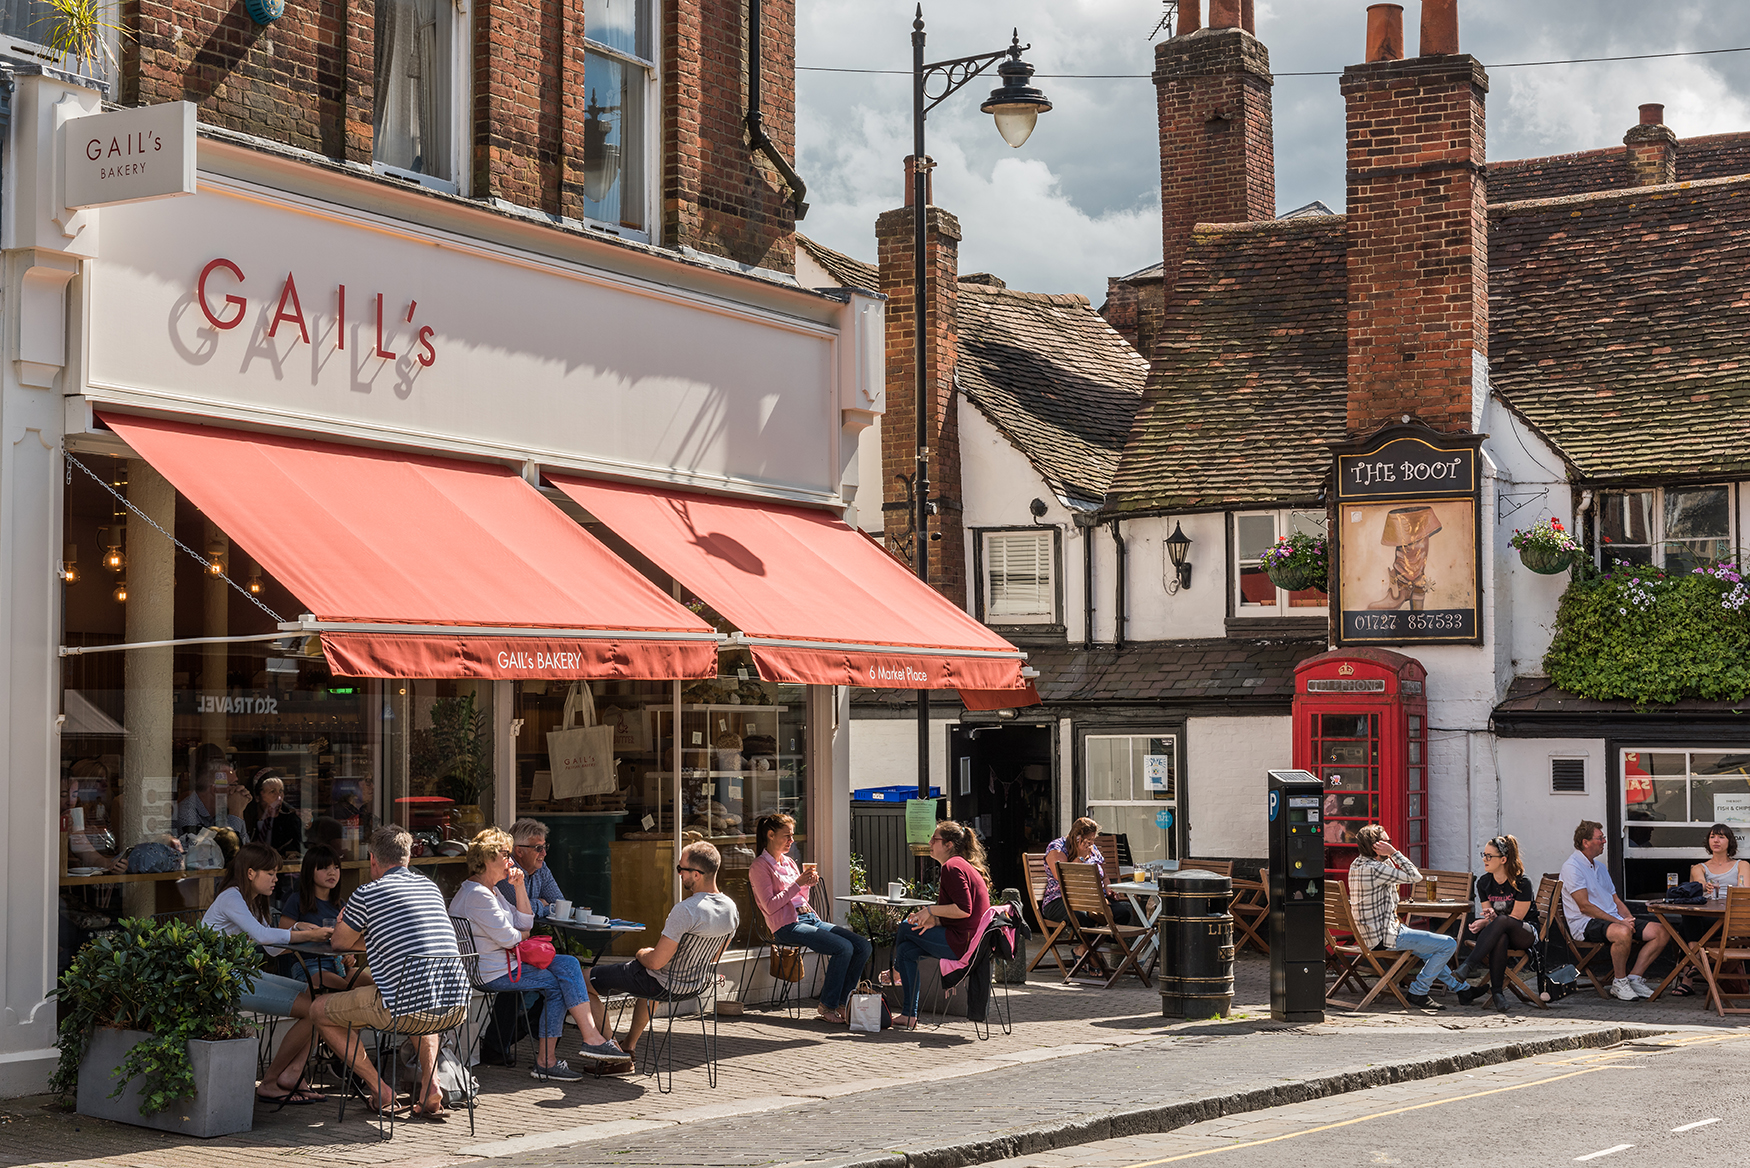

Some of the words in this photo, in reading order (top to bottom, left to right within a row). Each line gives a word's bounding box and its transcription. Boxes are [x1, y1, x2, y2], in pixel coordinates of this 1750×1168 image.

[86, 130, 162, 161] GAIL's
[100, 162, 146, 180] BAKERY
[197, 257, 436, 368] GAIL's
[1350, 461, 1397, 486] THE
[1400, 457, 1462, 481] BOOT
[1354, 613, 1397, 630] 01727
[1407, 612, 1463, 630] 857533
[497, 650, 534, 669] GAIL's
[536, 651, 582, 670] BAKERY
[869, 665, 876, 680] 6
[877, 664, 906, 681] Market
[906, 665, 928, 682] Place
[1312, 680, 1380, 691] TELEPHONE
[613, 735, 635, 745] UTTER
